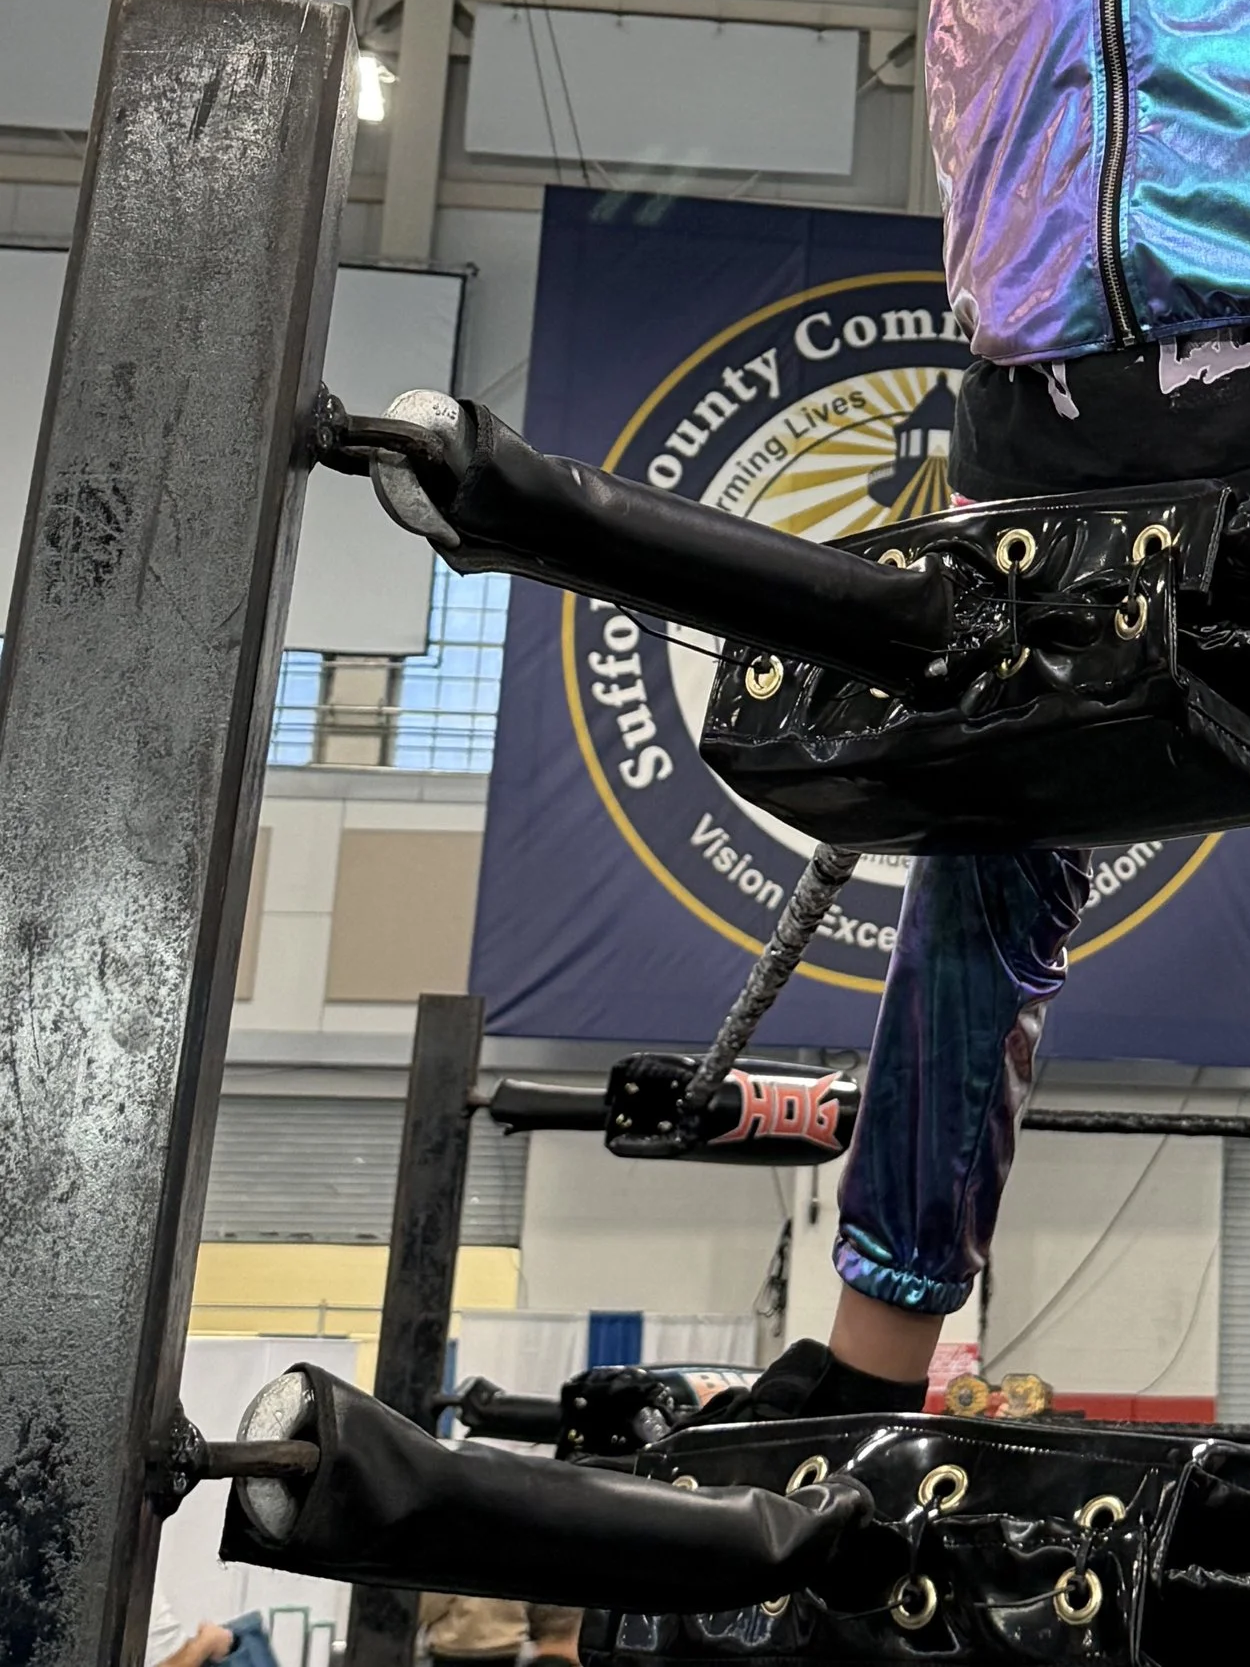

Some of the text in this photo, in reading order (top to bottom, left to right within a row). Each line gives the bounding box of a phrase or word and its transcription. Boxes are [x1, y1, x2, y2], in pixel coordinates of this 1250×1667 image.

[716, 387, 868, 513] rming Lives
[588, 307, 968, 790] Suffo ounty Com
[689, 812, 785, 911] Vision
[814, 902, 900, 953] Exce
[706, 1068, 843, 1151] HOG
